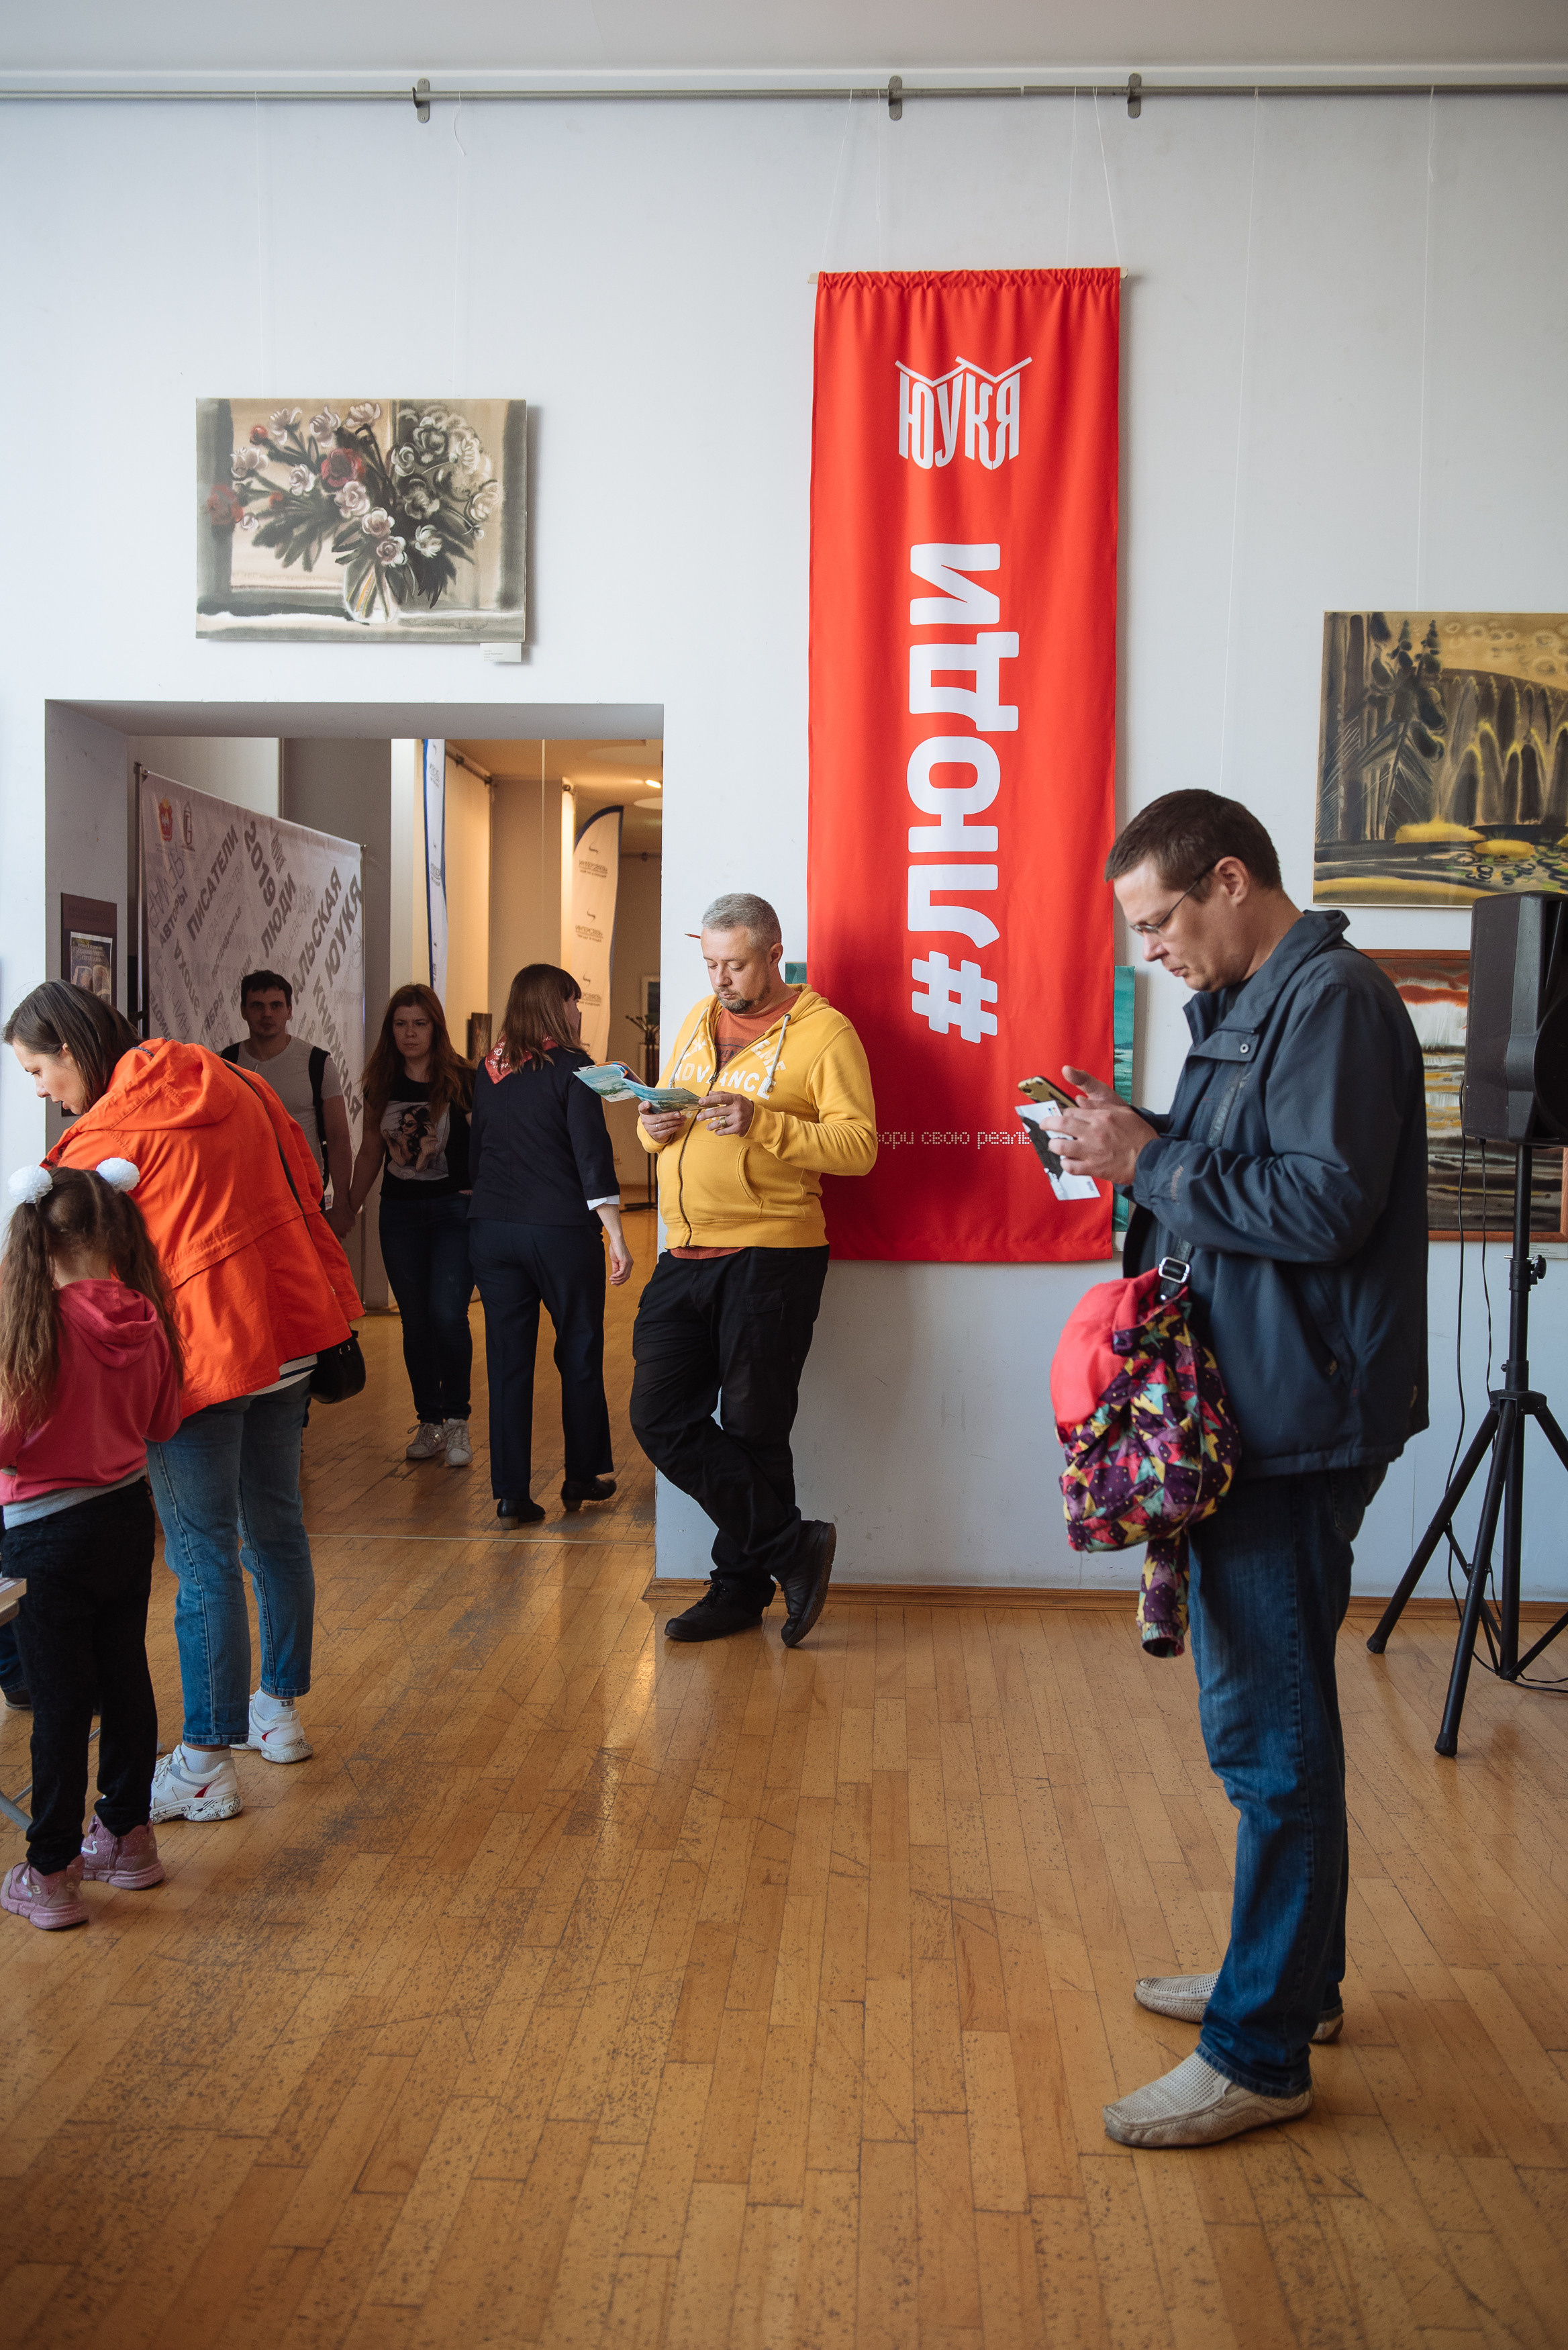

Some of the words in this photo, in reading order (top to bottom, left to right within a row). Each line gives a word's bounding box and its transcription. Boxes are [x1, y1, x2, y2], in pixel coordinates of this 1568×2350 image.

[895, 356, 1032, 470] ЮУКЯ
[906, 543, 1019, 1044] #ЛЮДИ
[159, 886, 189, 949] АВТОРЫ
[187, 824, 238, 941] ПИСАТЕЛИ
[244, 820, 276, 907] 2019
[261, 872, 297, 959] ЛЮДИ
[291, 865, 342, 1006] АЛЬСКАЯ
[325, 874, 362, 988] ЮУКЯ
[313, 974, 362, 1124] КНИЖНАЯ
[876, 1131, 915, 1149] ори
[921, 1131, 971, 1145] свою
[977, 1131, 1032, 1150] реаль
